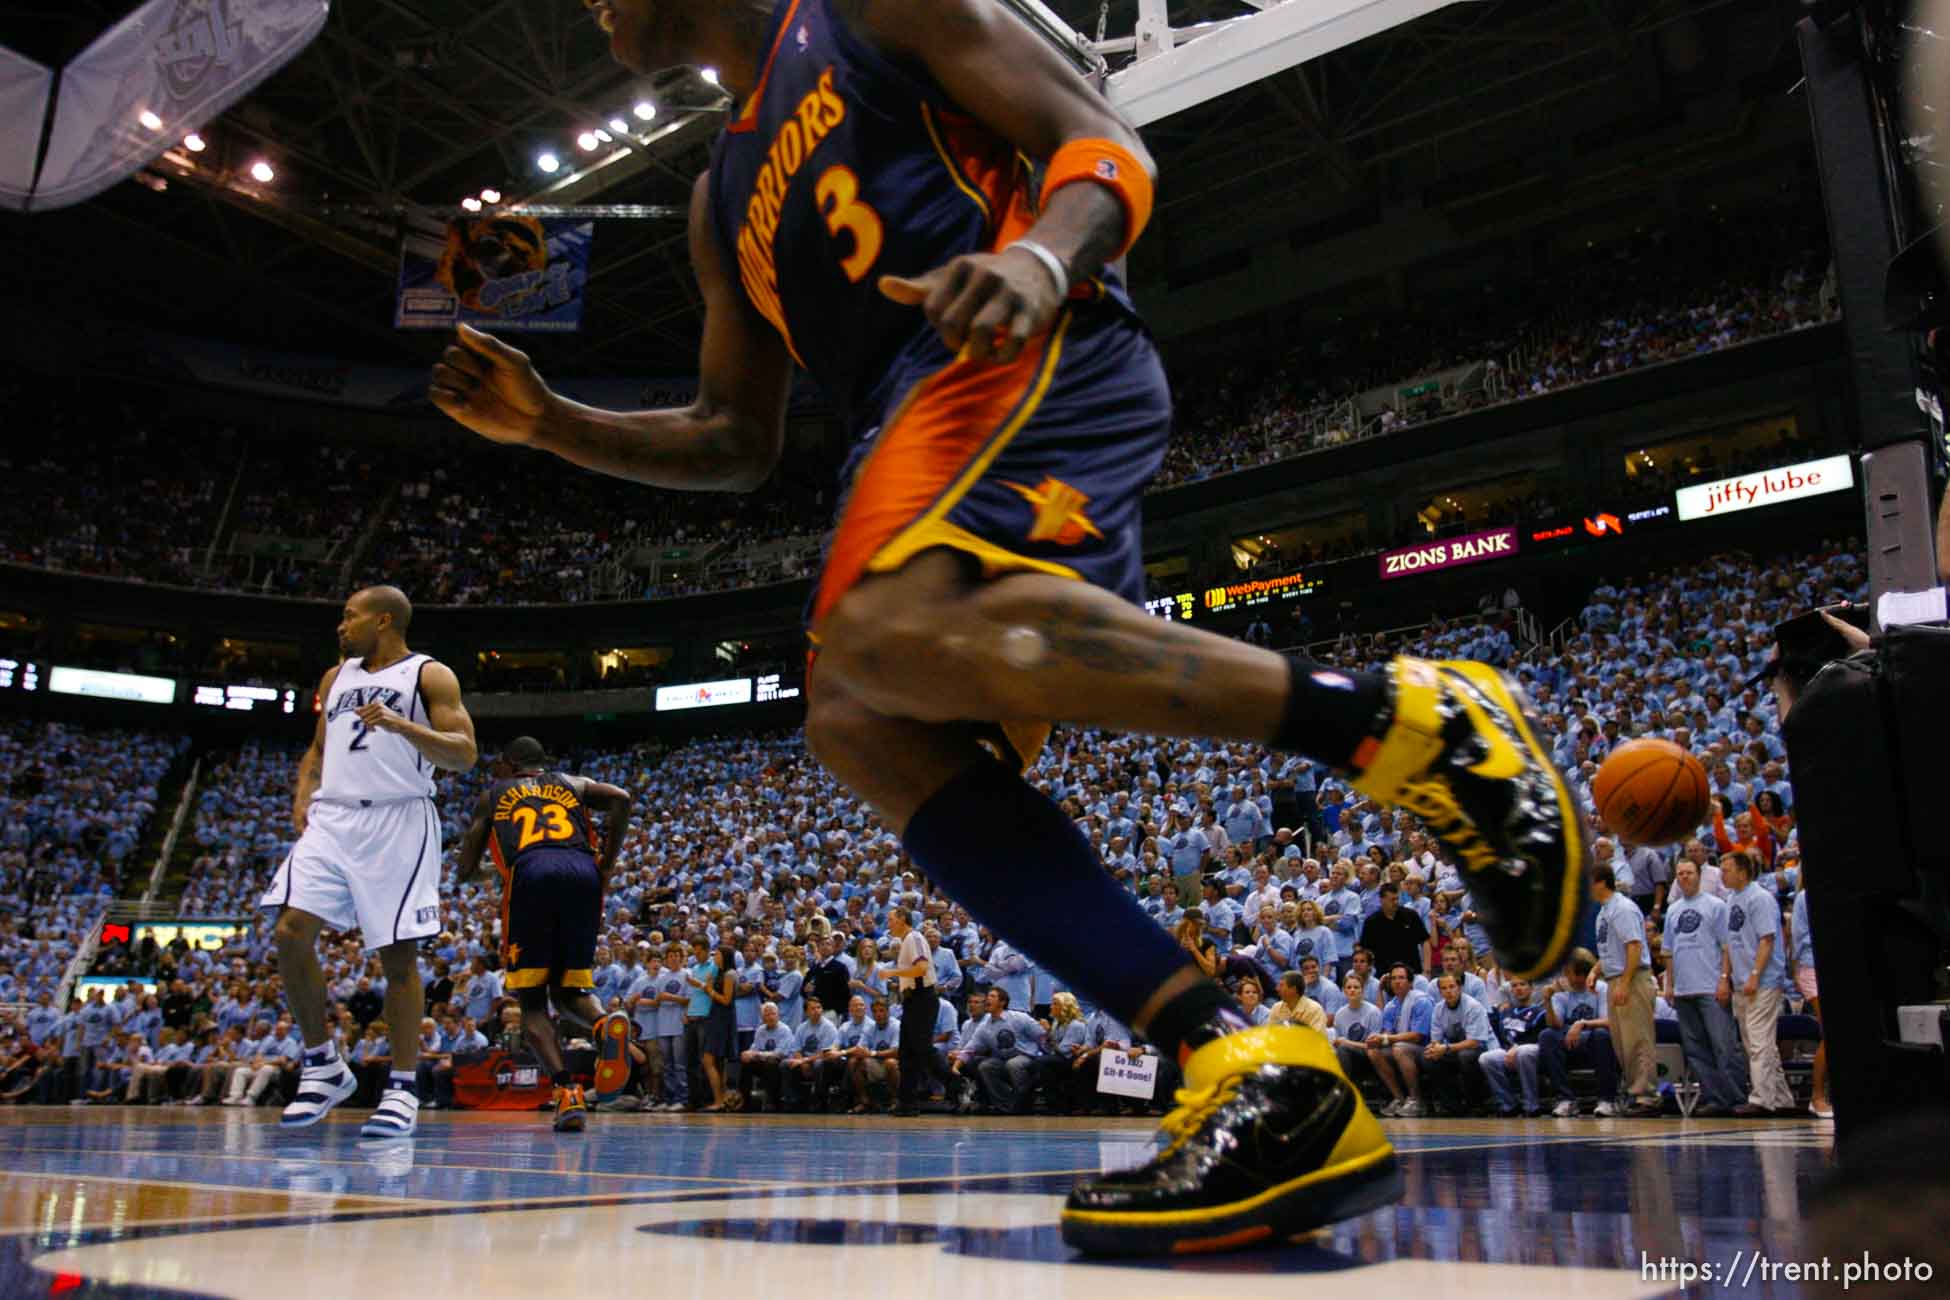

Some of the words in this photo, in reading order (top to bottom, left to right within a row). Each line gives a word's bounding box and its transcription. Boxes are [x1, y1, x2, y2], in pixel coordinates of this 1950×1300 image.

[815, 164, 884, 284] 3
[1704, 480, 1759, 513] jiffy
[1763, 471, 1822, 494] lube
[1386, 546, 1448, 574] ZIONS
[1451, 532, 1512, 561] BANK
[1226, 573, 1302, 596] WebPayment
[349, 719, 369, 752] 2
[494, 783, 580, 821] RICHARDSON
[512, 803, 575, 851] 23
